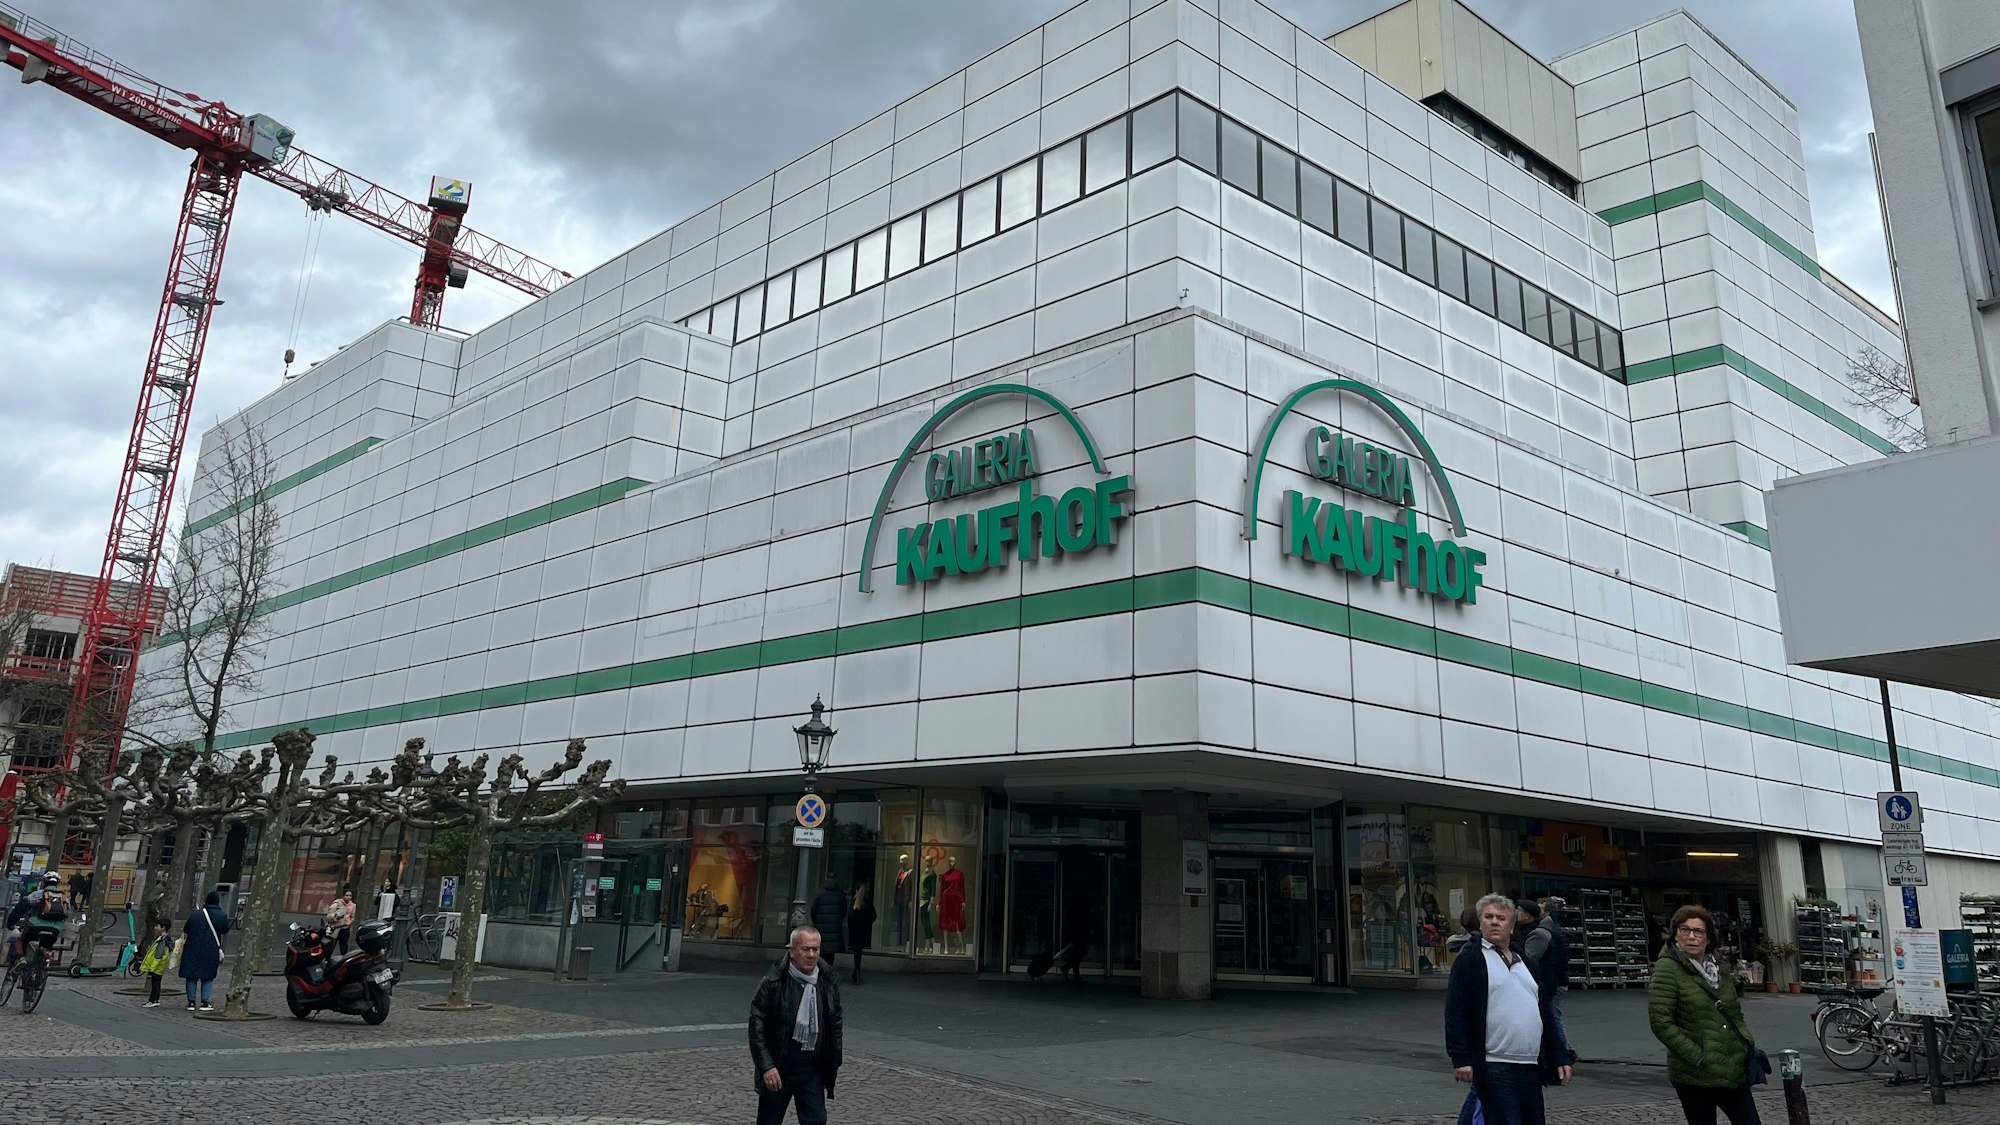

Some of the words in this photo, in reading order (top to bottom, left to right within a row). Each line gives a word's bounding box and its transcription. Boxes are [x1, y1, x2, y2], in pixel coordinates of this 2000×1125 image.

[111, 83, 127, 98] WT
[128, 93, 147, 109] 200
[924, 428, 1041, 501] GALERIA
[1305, 425, 1417, 507] GALERIA
[1562, 832, 1586, 857] Curry
[1901, 875, 1914, 883] frei
[1946, 953, 1970, 963] GALERIA
